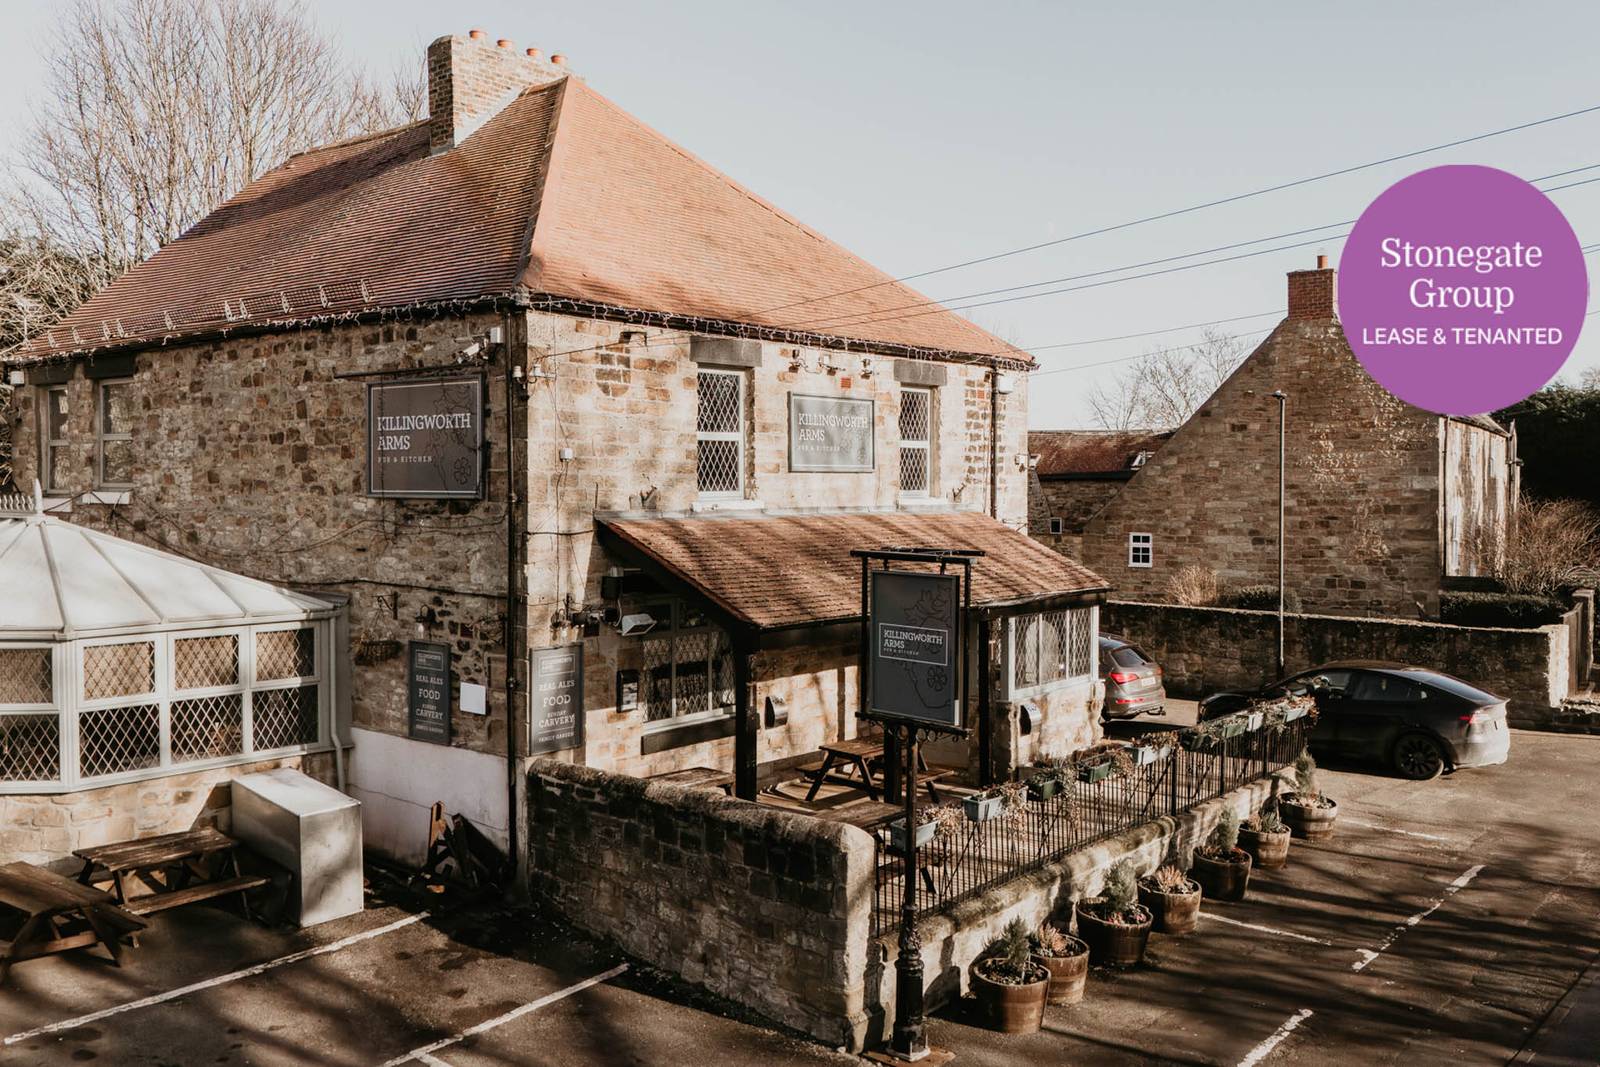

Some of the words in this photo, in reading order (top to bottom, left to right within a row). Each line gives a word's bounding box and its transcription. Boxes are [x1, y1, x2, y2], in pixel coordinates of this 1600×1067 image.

[377, 413, 472, 431] KILLINGWORTH
[798, 413, 868, 429] KILLINGWORTH
[798, 428, 825, 442] ARMS
[377, 435, 411, 450] ARMS
[883, 629, 944, 645] KILLINGWORTH
[883, 638, 905, 649] ARMS
[558, 679, 575, 689] ALES
[418, 688, 441, 700] FOOD
[543, 694, 571, 707] FOOD
[415, 708, 443, 720] CARVERY
[538, 714, 575, 728] CARVERY
